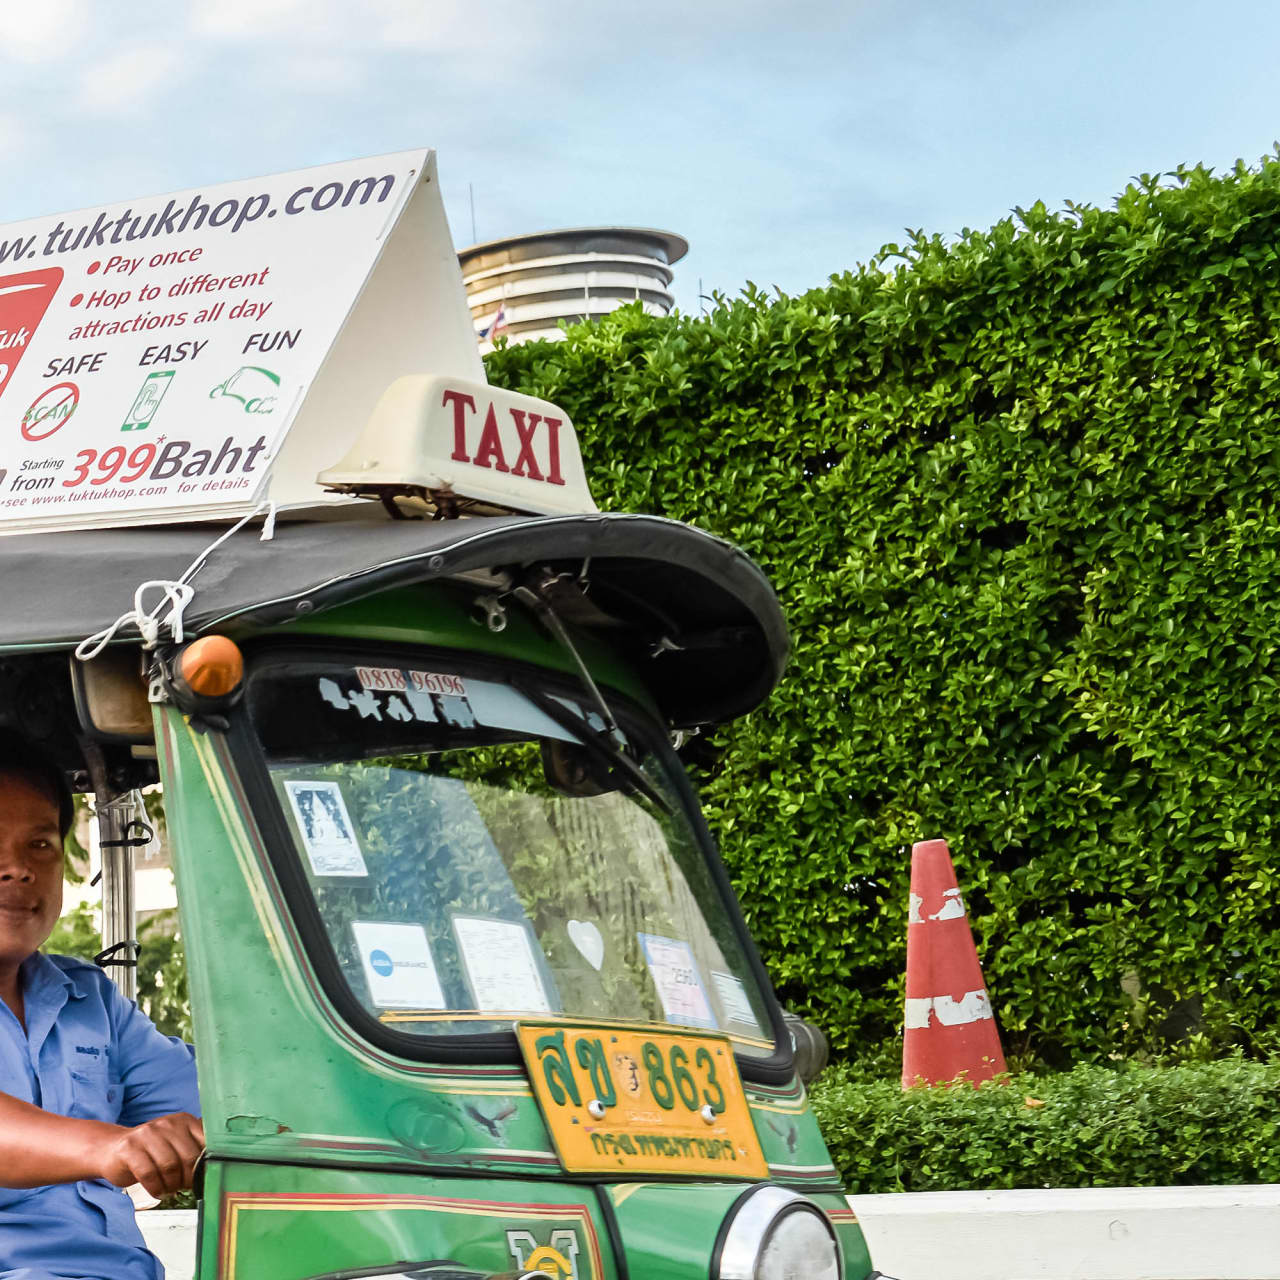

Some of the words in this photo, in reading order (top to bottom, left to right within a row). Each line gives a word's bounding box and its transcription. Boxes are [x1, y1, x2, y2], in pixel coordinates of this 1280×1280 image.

[102, 254, 144, 276] Pay
[148, 246, 203, 265] once
[86, 289, 130, 310] Hop
[140, 284, 161, 302] to
[168, 266, 270, 298] different
[68, 312, 187, 341] attractions
[193, 307, 222, 323] all
[228, 299, 273, 321] day
[43, 352, 108, 378] SAFE
[138, 339, 210, 366] EASY
[242, 328, 302, 354] FUN
[442, 390, 566, 486] TAXI
[9, 475, 55, 492] from
[149, 435, 266, 481] Baht
[19, 458, 65, 472] Starting
[31, 485, 167, 506] www.tuktukhop.com
[177, 481, 197, 494] for
[201, 478, 250, 492] details
[642, 1042, 725, 1114] 863
